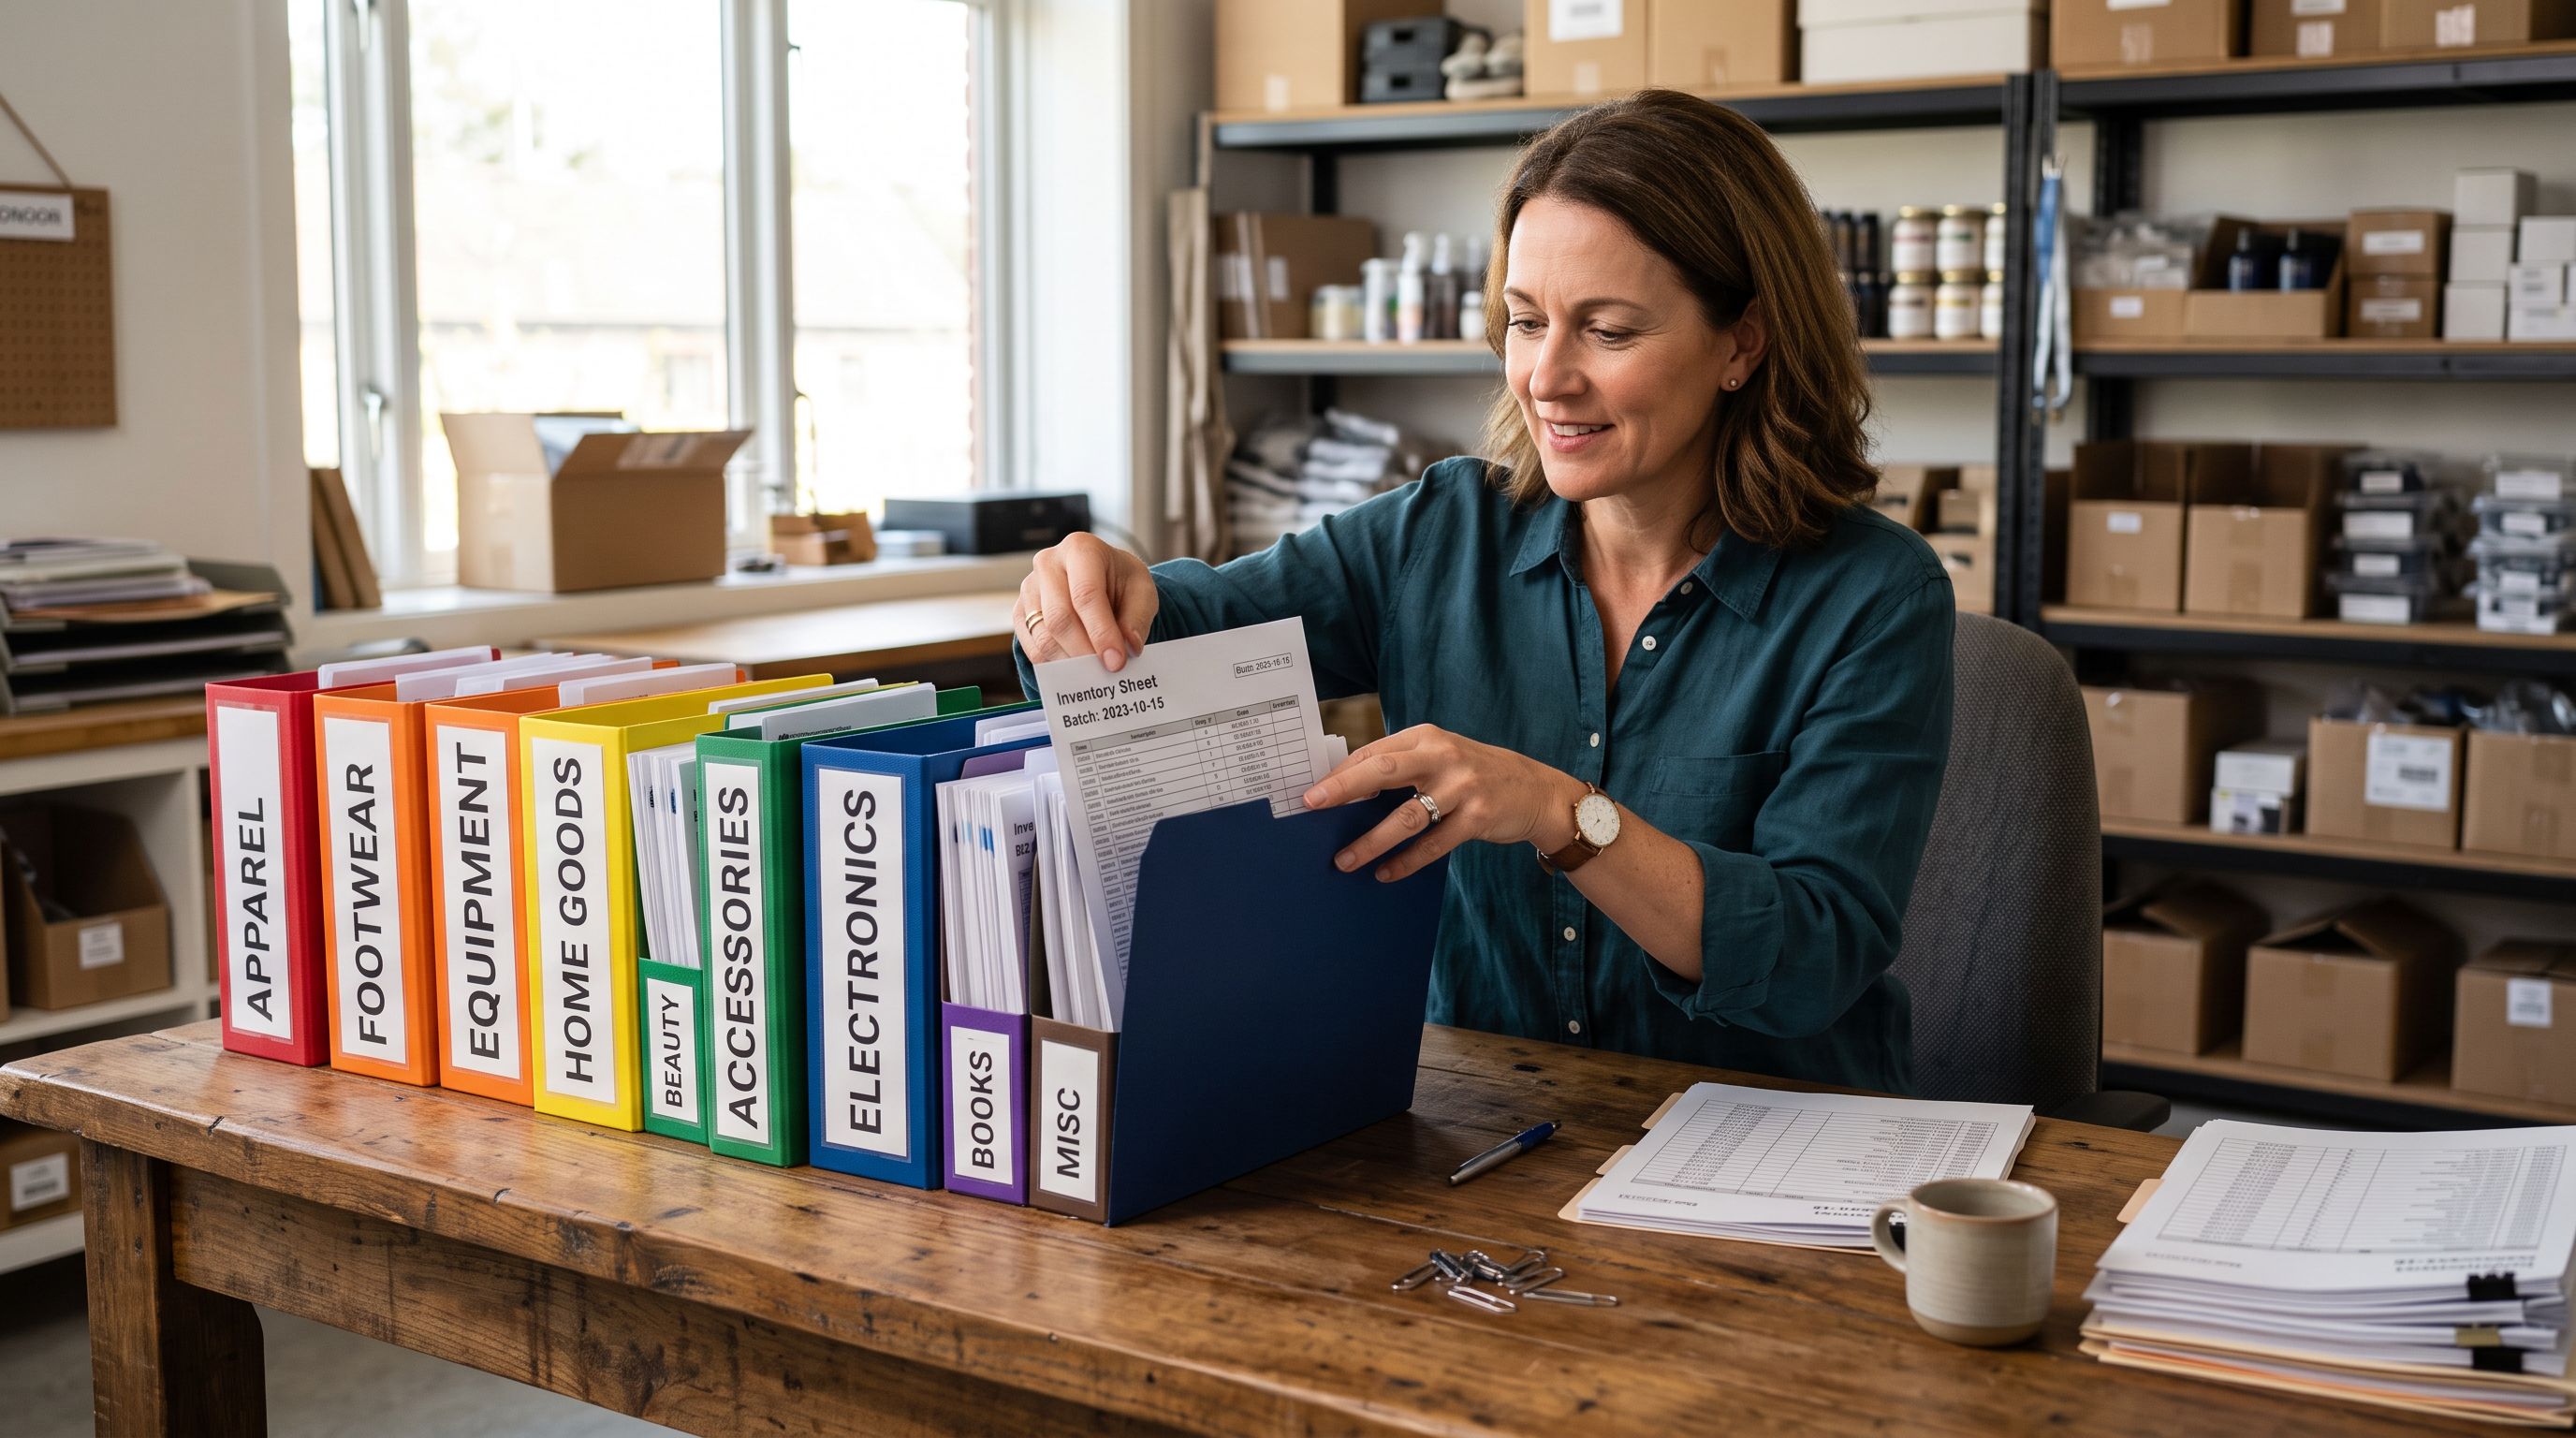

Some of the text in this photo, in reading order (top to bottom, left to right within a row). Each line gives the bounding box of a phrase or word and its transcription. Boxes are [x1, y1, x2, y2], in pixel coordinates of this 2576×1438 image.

[1056, 674, 1159, 706] Inventory Sheet
[1062, 697, 1164, 728] Batch: 2023-10-15
[238, 798, 273, 1022] APPAREL
[346, 763, 388, 1046] FOOTWEAR
[456, 741, 500, 1060] EQUIPMENT
[553, 757, 593, 1083] HOME GOODS
[718, 785, 758, 1130] ACCESSORIES
[843, 789, 882, 1135] ELECTRONICS
[661, 993, 683, 1108] BEAUTY
[970, 1050, 995, 1169] BOOKS
[1056, 1087, 1081, 1180] MISC
